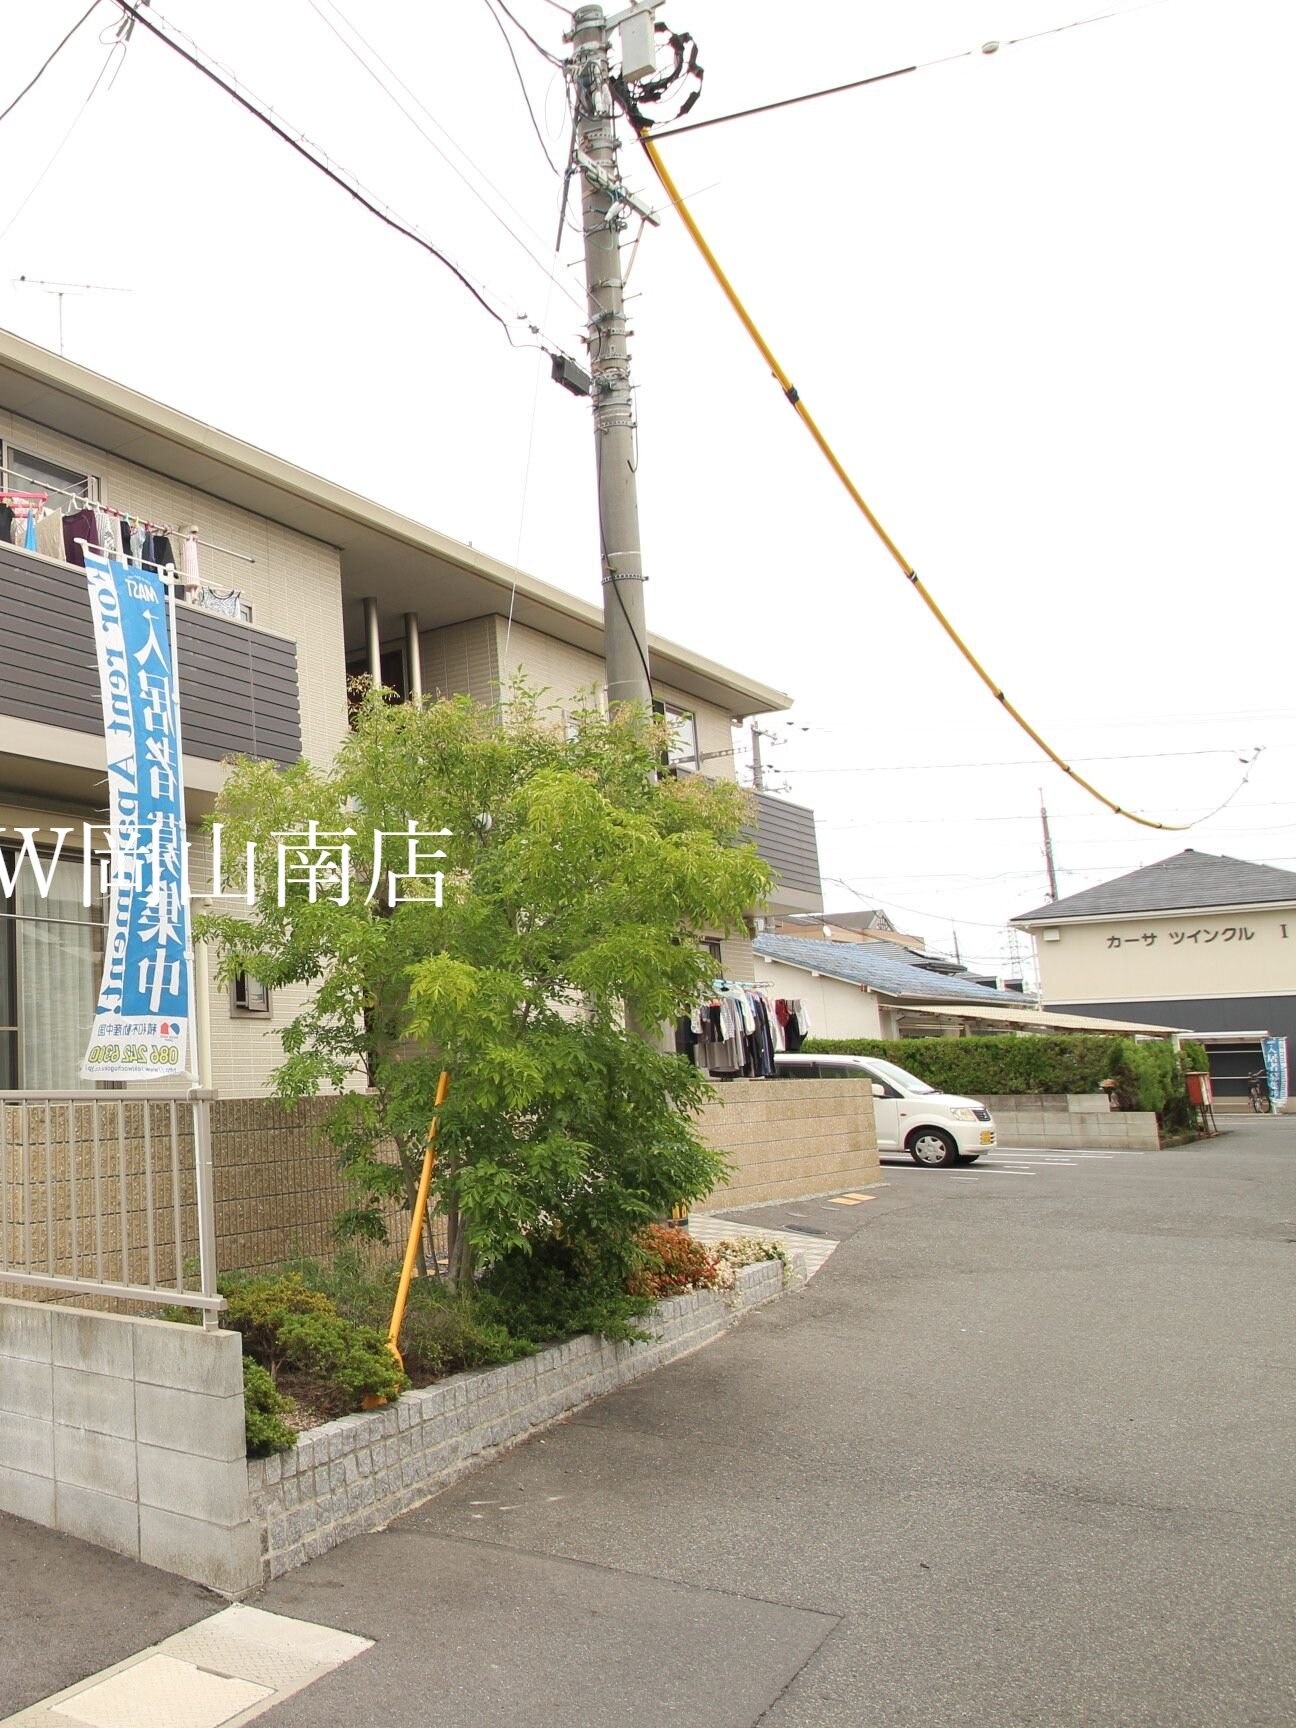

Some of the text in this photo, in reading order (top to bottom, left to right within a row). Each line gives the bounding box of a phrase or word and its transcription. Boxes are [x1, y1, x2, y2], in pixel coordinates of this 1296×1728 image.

[1107, 933, 1157, 949] カーサ
[1168, 927, 1255, 945] ツインクル
